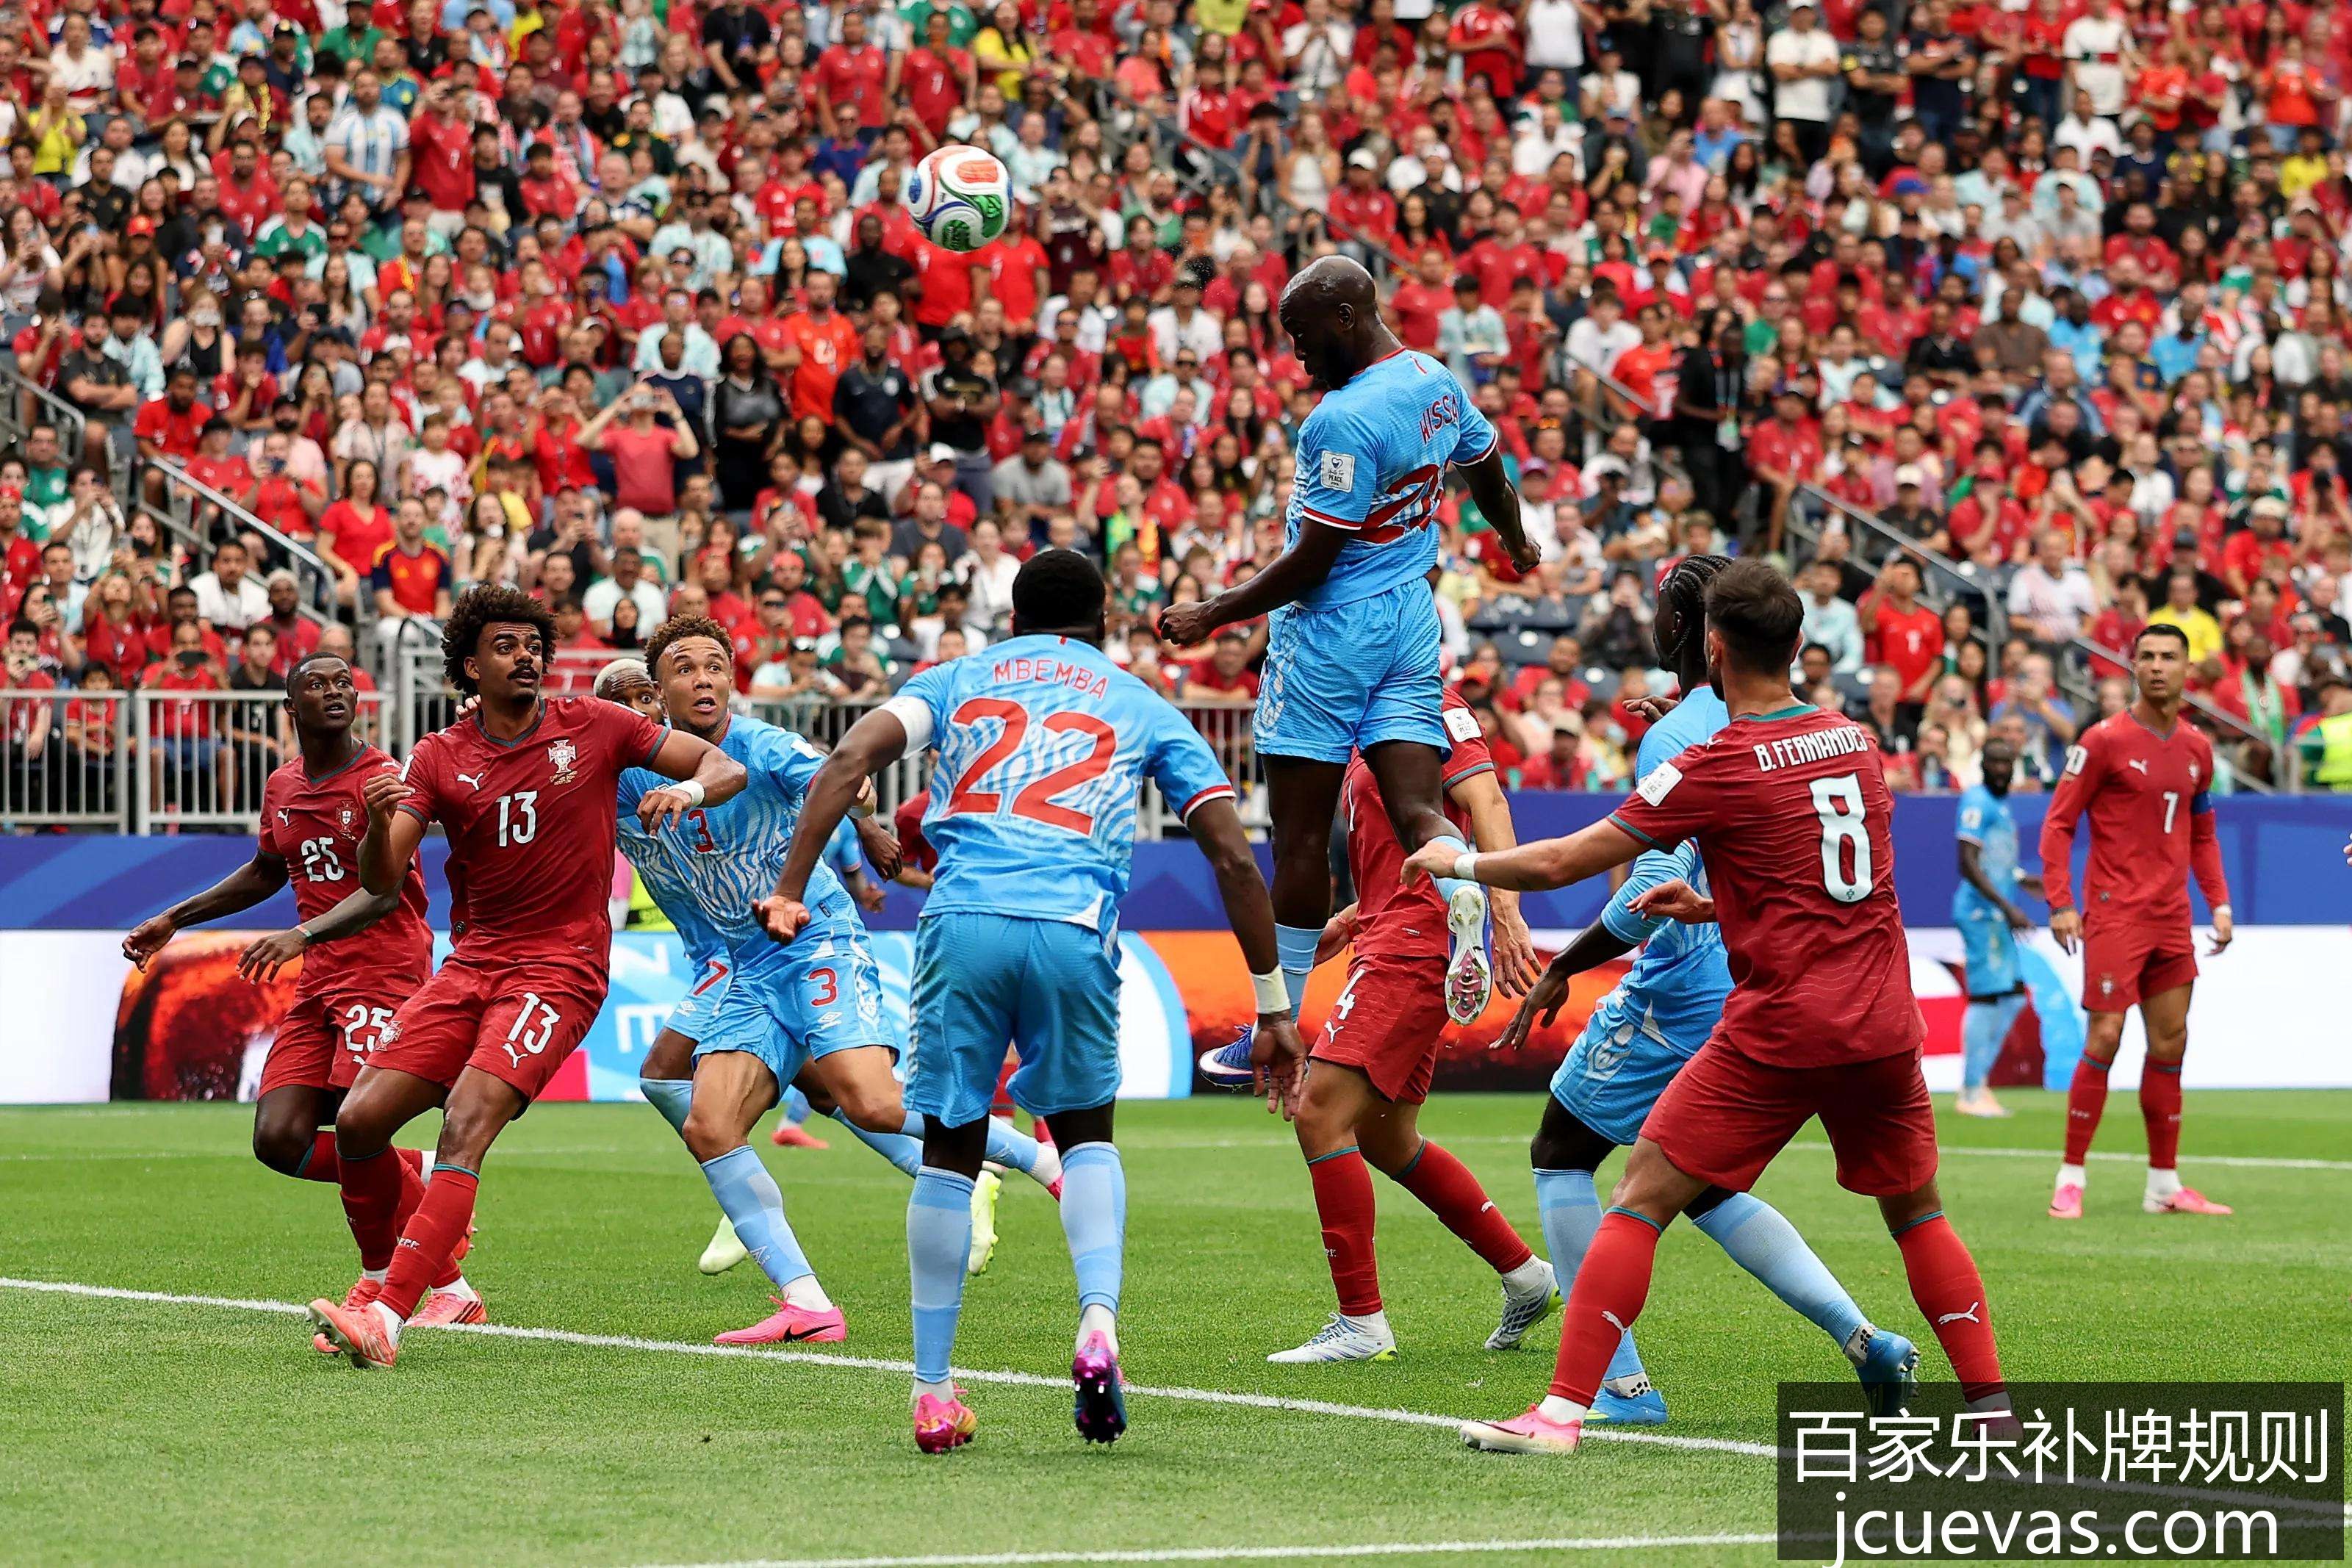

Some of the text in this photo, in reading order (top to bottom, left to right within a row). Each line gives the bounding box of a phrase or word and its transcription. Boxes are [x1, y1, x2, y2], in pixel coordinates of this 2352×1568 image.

[994, 658, 1110, 700] MBEMBA
[943, 697, 1118, 837] 22
[495, 790, 538, 847] 13
[687, 809, 714, 853] 3
[2163, 791, 2179, 835] 7
[301, 836, 345, 882] 25
[1808, 772, 1874, 902] 8
[693, 959, 730, 996] 7
[808, 966, 840, 1007] 3
[1335, 968, 1366, 1020] 4
[345, 1004, 392, 1052] 25
[508, 992, 561, 1054] 13
